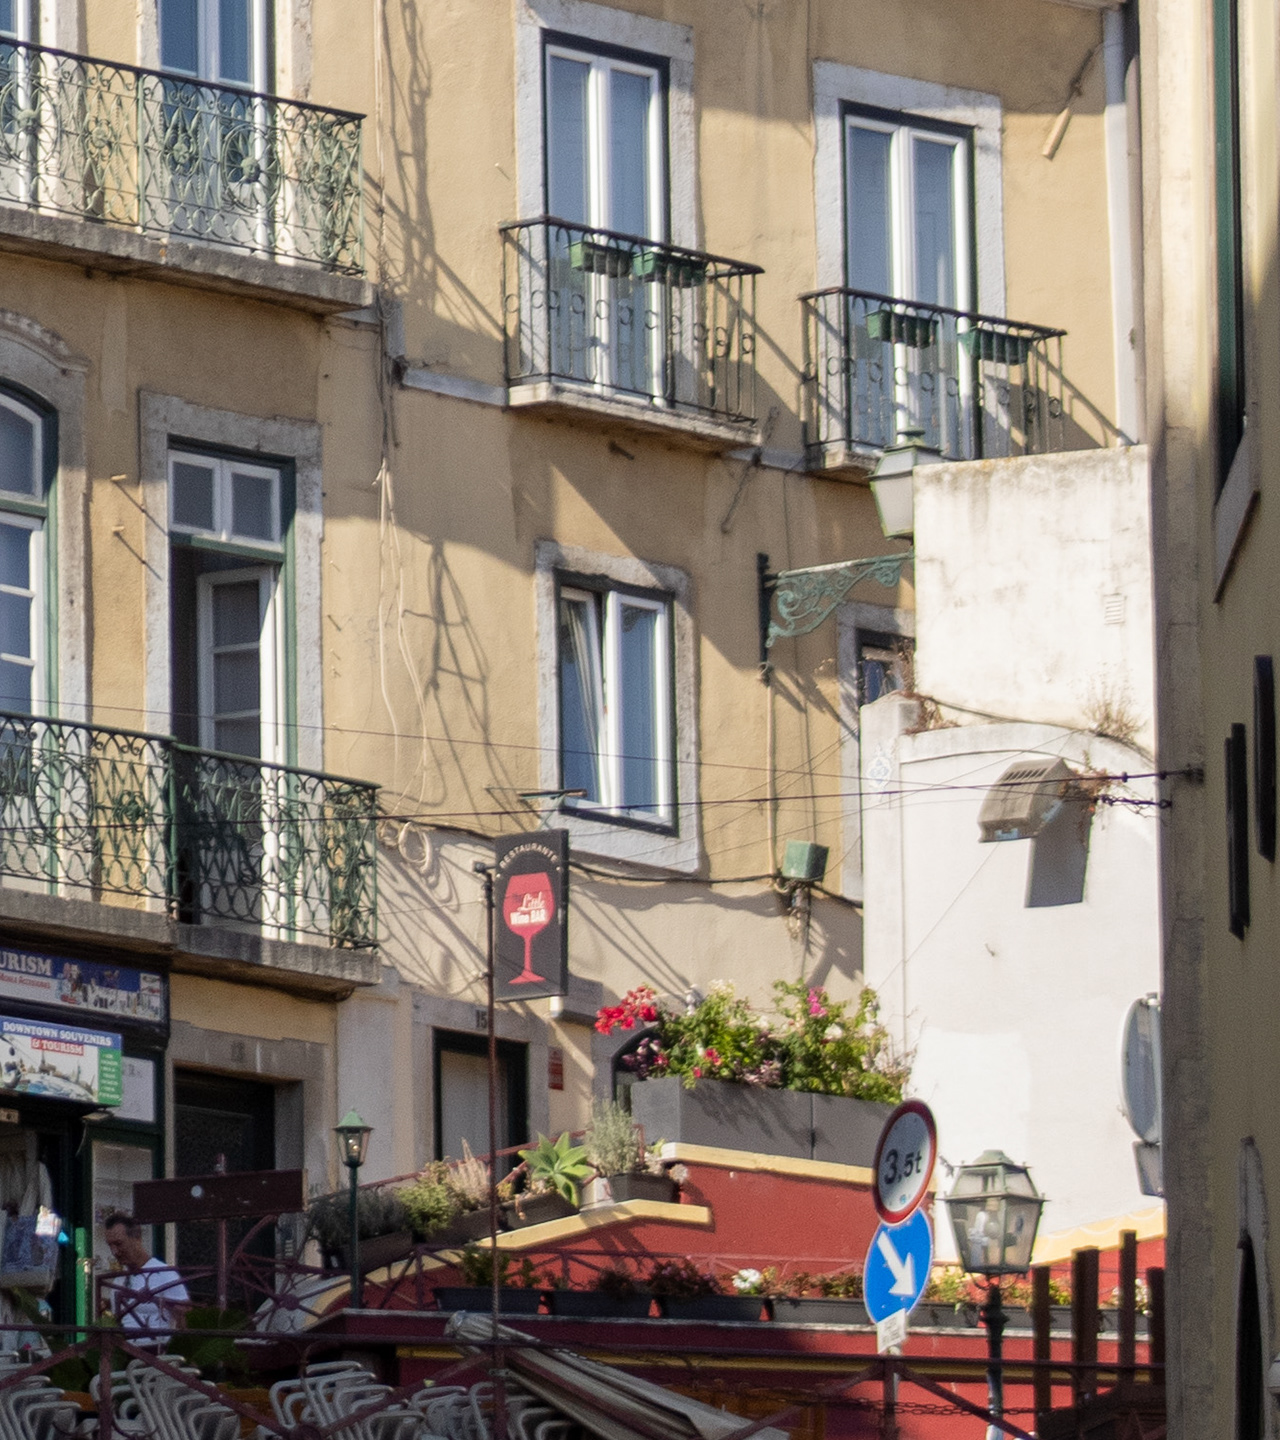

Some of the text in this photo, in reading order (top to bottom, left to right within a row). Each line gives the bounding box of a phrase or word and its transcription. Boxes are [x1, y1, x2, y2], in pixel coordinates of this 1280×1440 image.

[499, 842, 558, 868] RESTAURANTE
[517, 891, 546, 911] Little
[510, 908, 547, 925] Wine BAR
[3, 1021, 113, 1046] DOWNTOWN SOUVENIRS
[32, 1038, 83, 1054] & TOURISM
[883, 1149, 923, 1185] 3,5t
